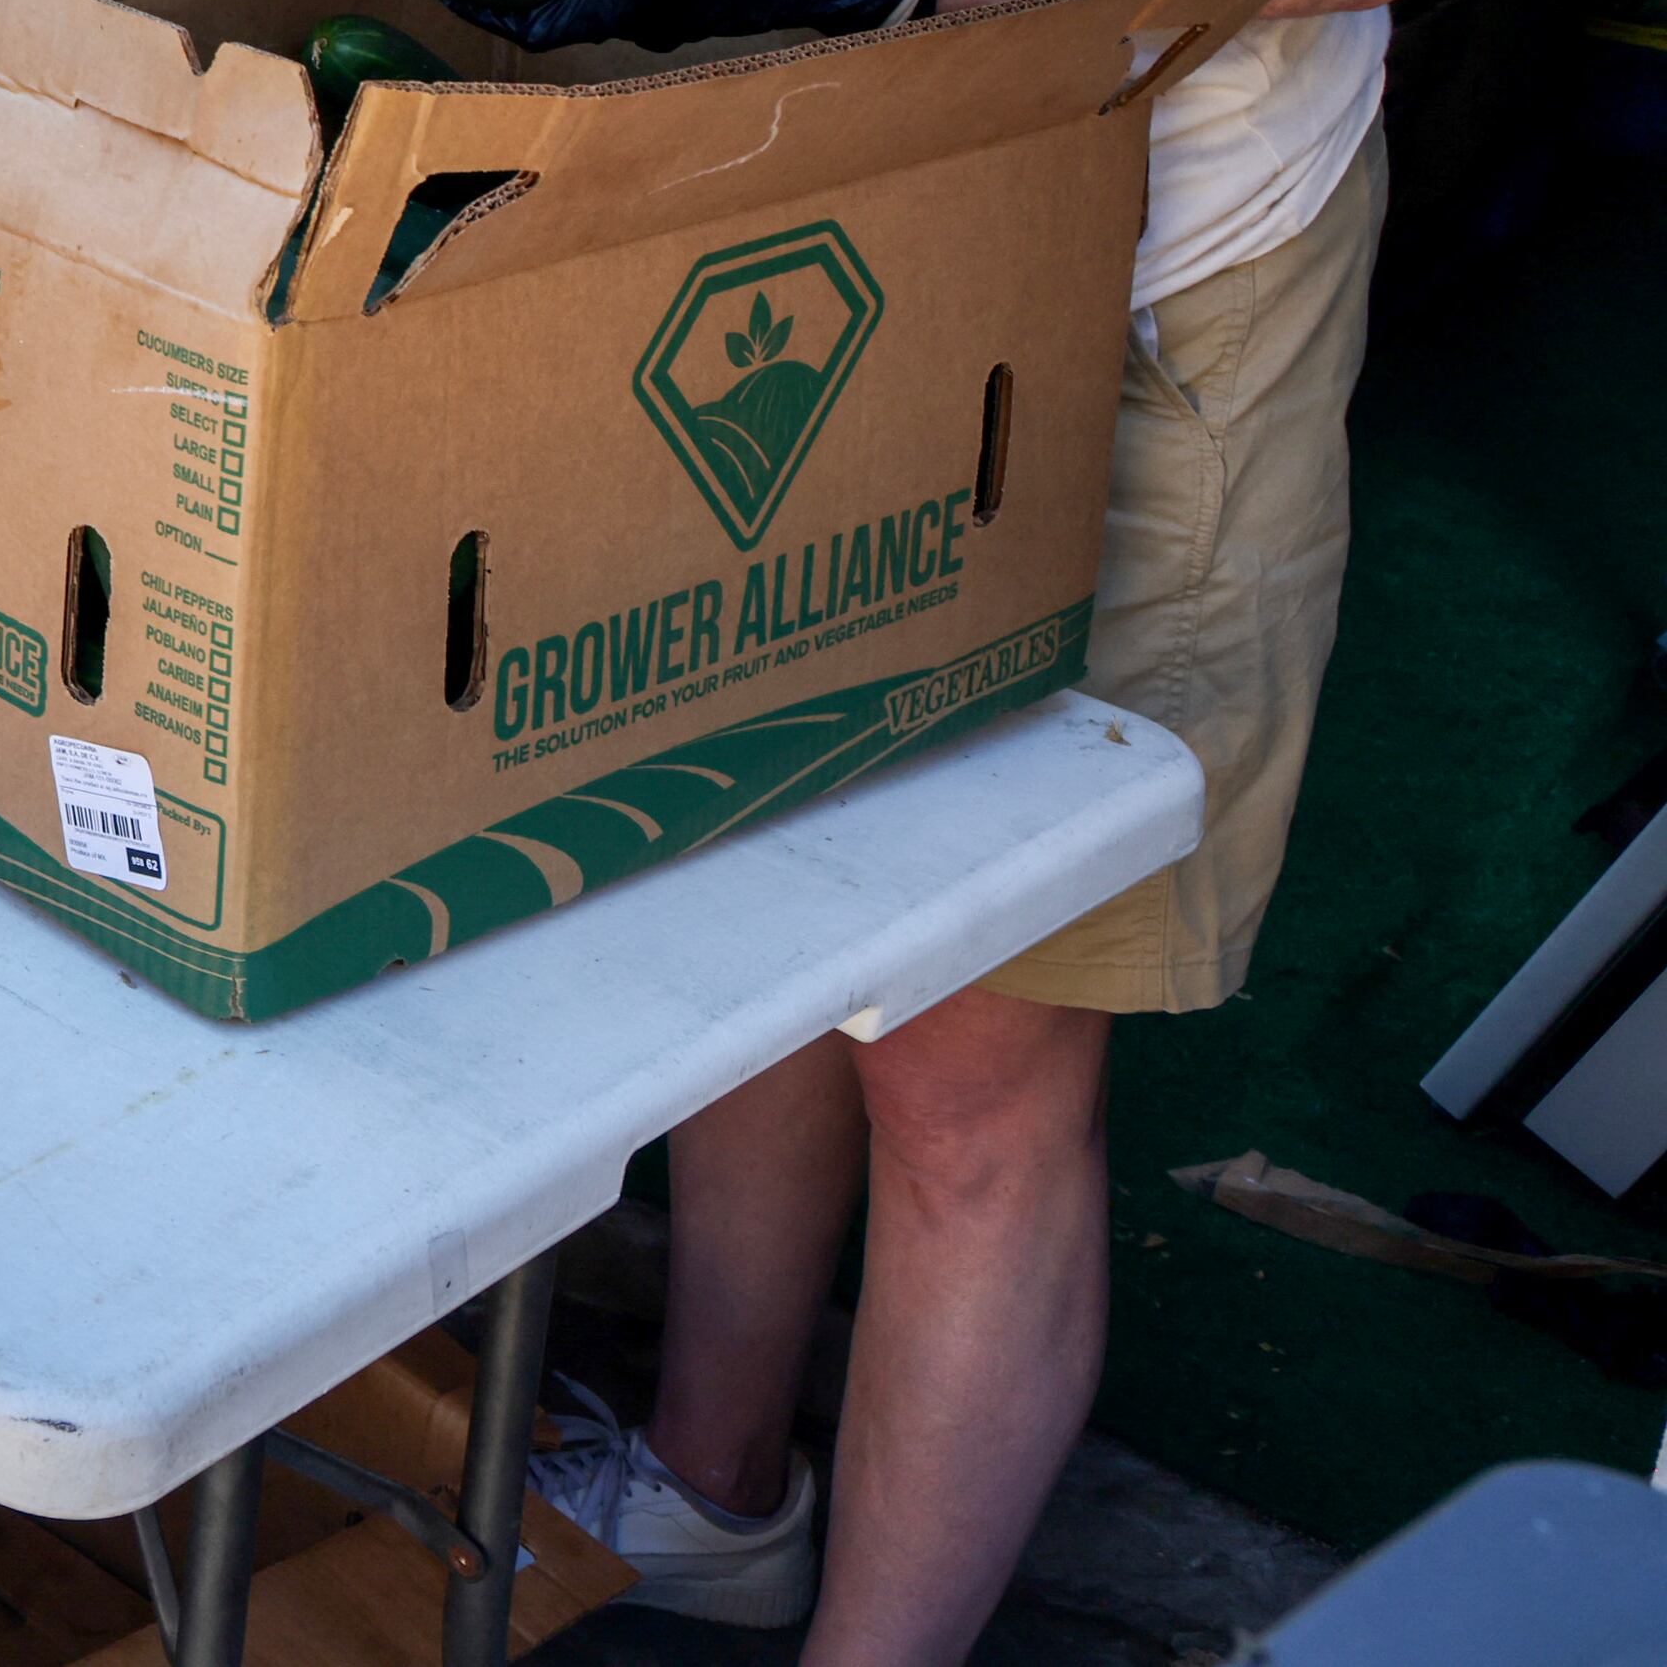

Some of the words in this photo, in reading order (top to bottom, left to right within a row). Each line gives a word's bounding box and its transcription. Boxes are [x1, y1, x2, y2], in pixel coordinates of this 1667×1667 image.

[137, 330, 214, 375] CUCUMBERS
[216, 363, 249, 385] SIZE
[166, 372, 208, 402] SUPER
[170, 403, 219, 434] SELECT
[174, 434, 217, 464] LARGE
[173, 462, 215, 493] SMALL
[176, 493, 214, 522] PLAIN
[155, 520, 202, 553] OPTION
[141, 570, 172, 597] CHILI
[174, 585, 233, 622] PEPPERS
[142, 596, 207, 637] JALAPEÑO
[493, 579, 723, 742] GROWER
[733, 488, 971, 657] ALLIANCE
[146, 624, 206, 663] POBLANO
[5, 679, 36, 703] NEEDS
[158, 658, 204, 692] CARIBE
[492, 742, 530, 773] THE
[534, 710, 627, 759] SOLUTION
[631, 694, 666, 721] FOR
[670, 674, 718, 708] YOUR
[722, 653, 770, 687] FRUIT
[774, 638, 809, 667] AND
[814, 602, 905, 651] VEGETABLE
[907, 581, 959, 615] NEEDS
[889, 623, 1057, 732] VEGETABLES
[146, 681, 203, 719] ANAHEIM
[134, 701, 201, 745] SERRANOS
[158, 801, 191, 827] Packed
[146, 858, 159, 872] 62
